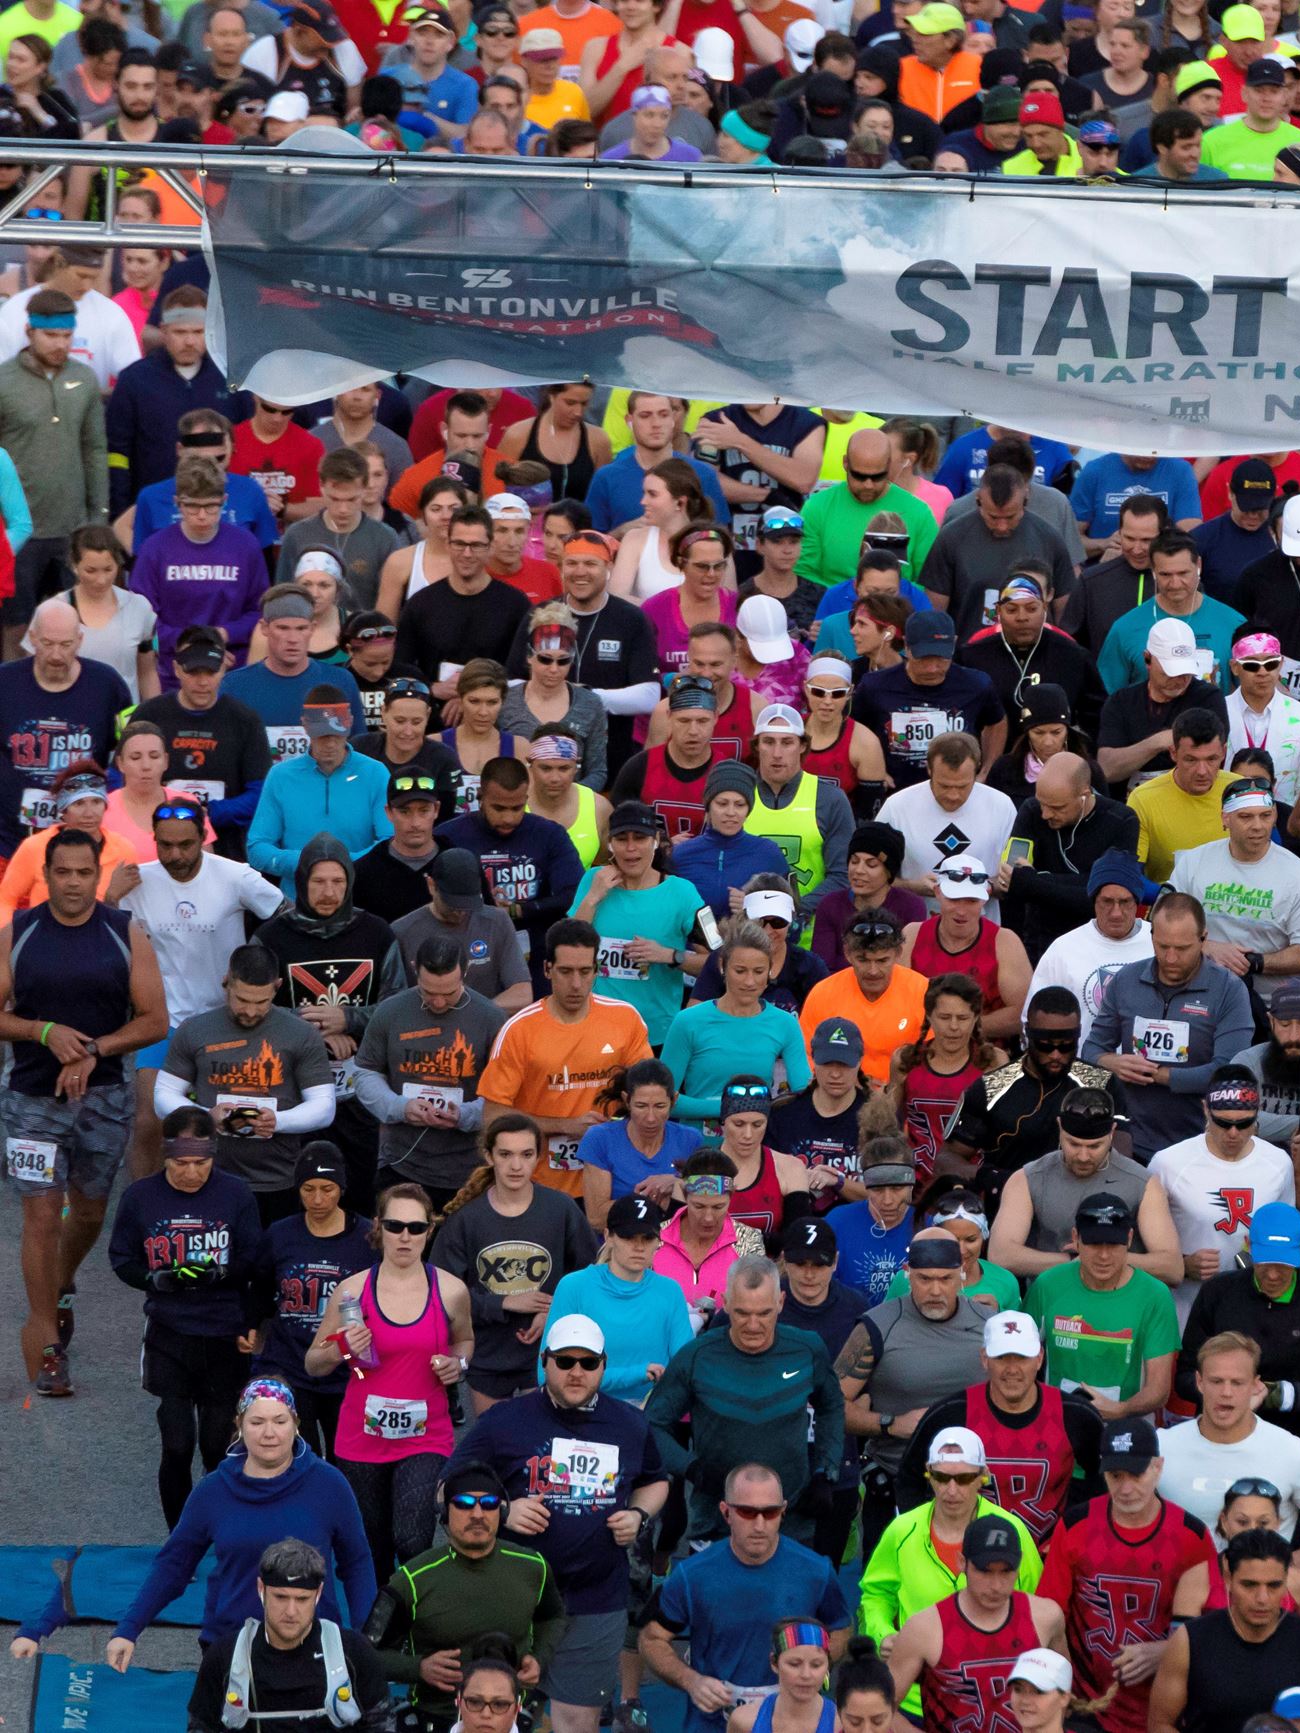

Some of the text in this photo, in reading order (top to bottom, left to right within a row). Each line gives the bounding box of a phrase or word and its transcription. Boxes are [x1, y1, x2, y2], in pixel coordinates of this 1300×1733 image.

[388, 286, 680, 317] BENTONVILLE
[890, 258, 1288, 358] START
[167, 565, 240, 582] EVANSVILLE
[904, 722, 934, 741] 850
[51, 736, 66, 758] IS
[67, 733, 93, 756] NO
[277, 737, 309, 756] 933
[496, 863, 537, 884] IS NO
[1204, 890, 1274, 910] BENTONVILLE
[1143, 1030, 1174, 1051] 426
[634, 1200, 648, 1219] 3
[188, 1235, 203, 1251] IS
[204, 1230, 230, 1250] NO
[805, 1225, 818, 1245] 3
[868, 1283, 892, 1295] ROA
[1055, 1319, 1082, 1334] OUTBACK
[1054, 1335, 1079, 1350] OZARKS
[378, 1409, 412, 1430] 285
[568, 1455, 601, 1477] 192
[985, 1529, 1009, 1547] R
